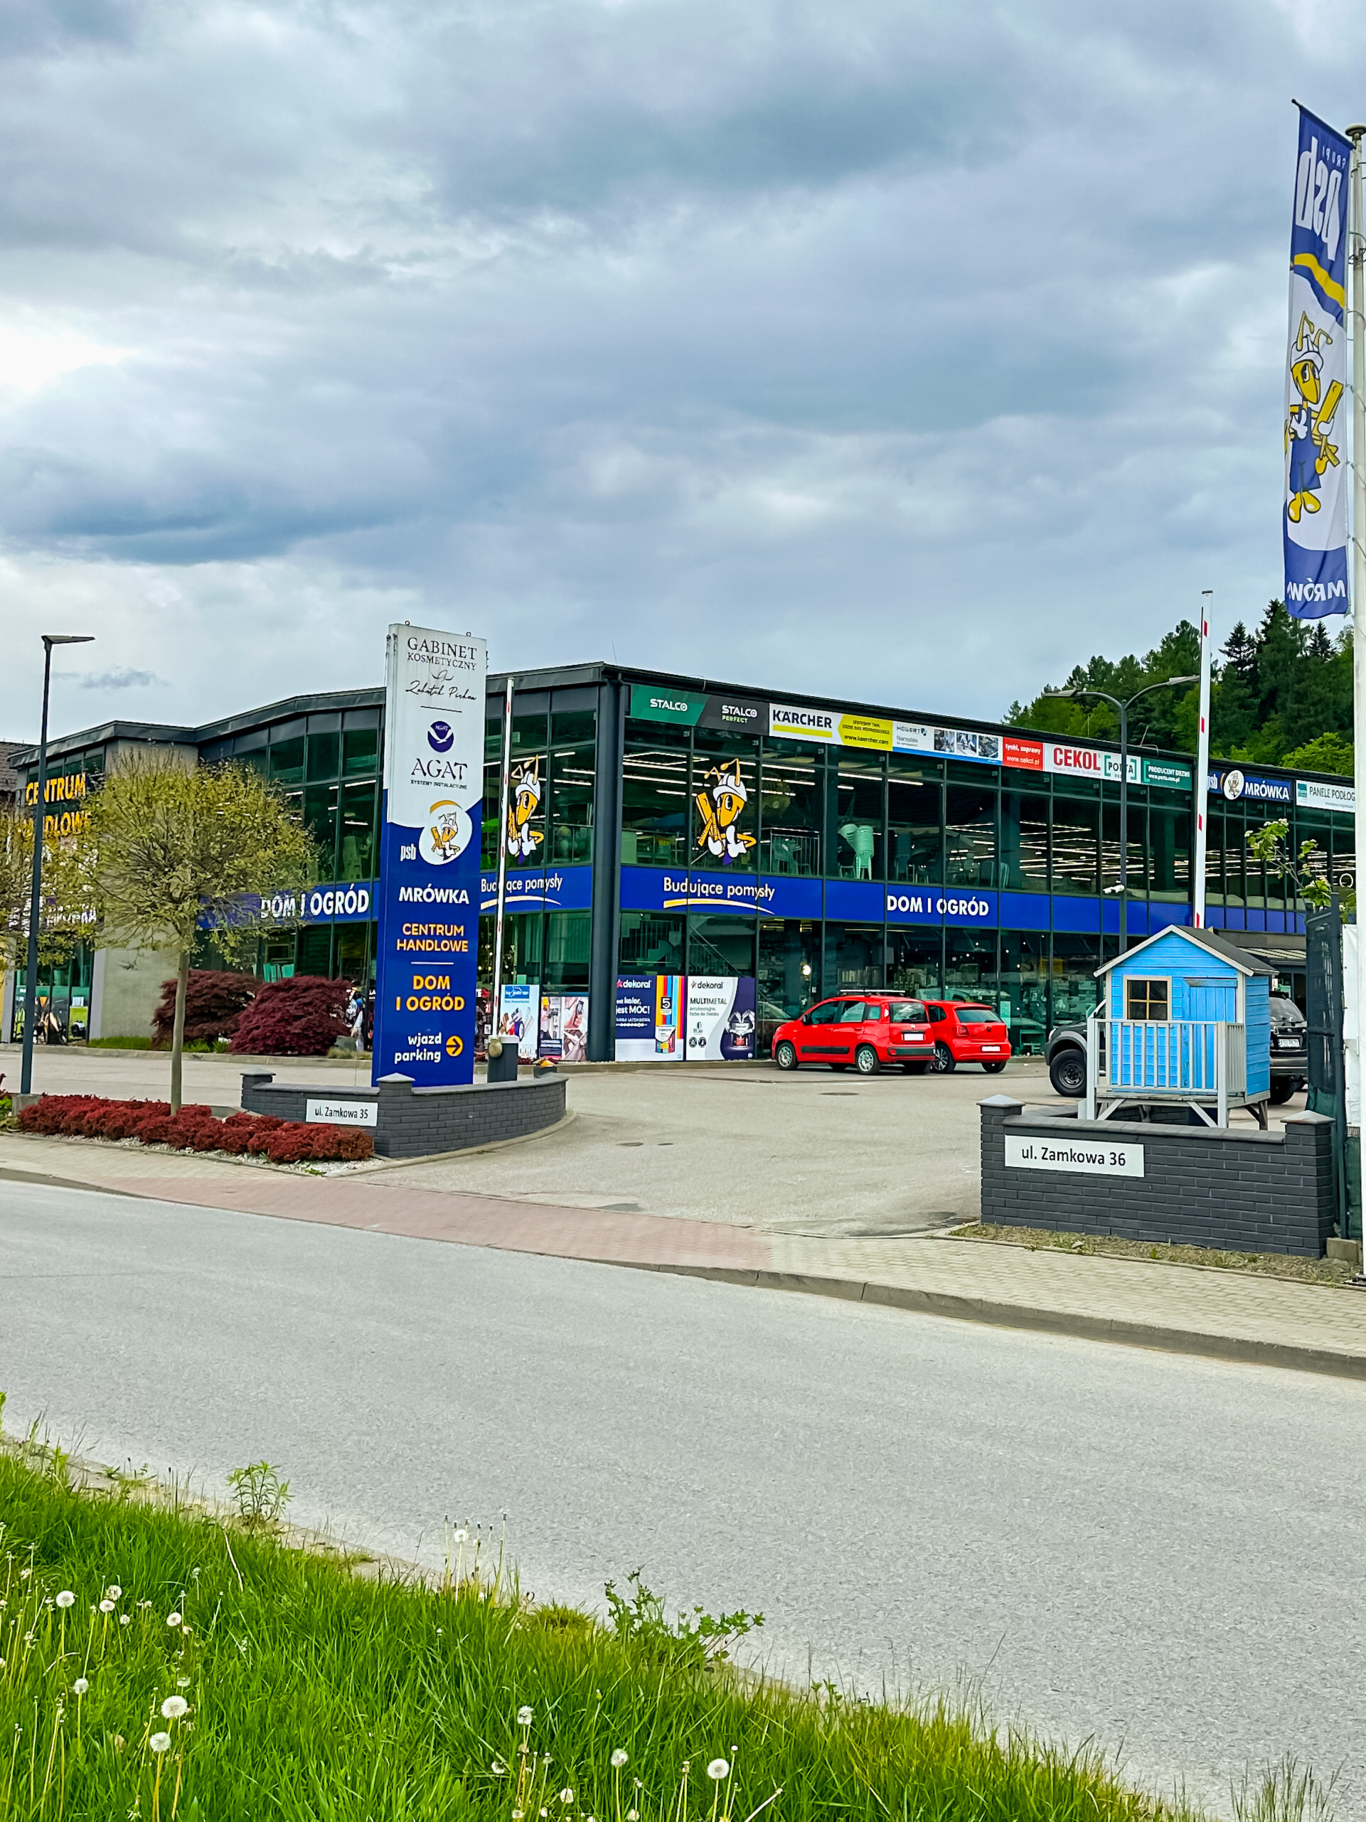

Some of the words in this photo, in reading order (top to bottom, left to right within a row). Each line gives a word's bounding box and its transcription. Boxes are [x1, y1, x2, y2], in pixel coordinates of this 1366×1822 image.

[407, 637, 477, 660] GABINET
[407, 652, 477, 671] KOSMETYCZNY
[650, 699, 688, 712] STALCO
[722, 705, 757, 718] STALCO
[722, 715, 748, 723] PERFECT
[772, 709, 832, 729] KÄRCHER
[1006, 755, 1040, 765] www.cekol.pl
[1053, 747, 1101, 771] CEKOL
[411, 757, 468, 781] AGAT
[1148, 765, 1175, 775] PRODUCENT
[1245, 780, 1290, 800] MRÓWKA
[1309, 786, 1331, 798] PANELE
[1332, 789, 1356, 801] PODŁOG
[400, 843, 416, 861] psb
[525, 872, 563, 893] pomysły
[663, 877, 723, 897] Budujące
[727, 883, 775, 901] pomysły
[261, 895, 296, 918] DOM
[310, 884, 369, 915] OGRÓD
[399, 884, 470, 905] MRÓWKA
[887, 895, 923, 913] DOM
[927, 898, 932, 913] I
[936, 896, 989, 916] OGRÓD
[402, 923, 464, 937] CENTRUM
[396, 939, 469, 952] HANDLOWE
[413, 975, 450, 990] DOM
[623, 980, 650, 988] dekoral
[697, 981, 723, 989] dekoral
[396, 996, 401, 1011] I
[406, 990, 465, 1011] OGRÓD
[690, 997, 727, 1005] MULTIMETAL
[629, 1005, 650, 1014] MOC!
[408, 1032, 442, 1046] wjazd
[394, 1048, 442, 1063] parking
[315, 1106, 323, 1116] ul.
[325, 1107, 358, 1118] Zamkowa
[359, 1109, 368, 1119] 35
[1021, 1145, 1037, 1160] ul.
[1041, 1147, 1105, 1165] Zamkowa
[1109, 1152, 1126, 1166] 36
